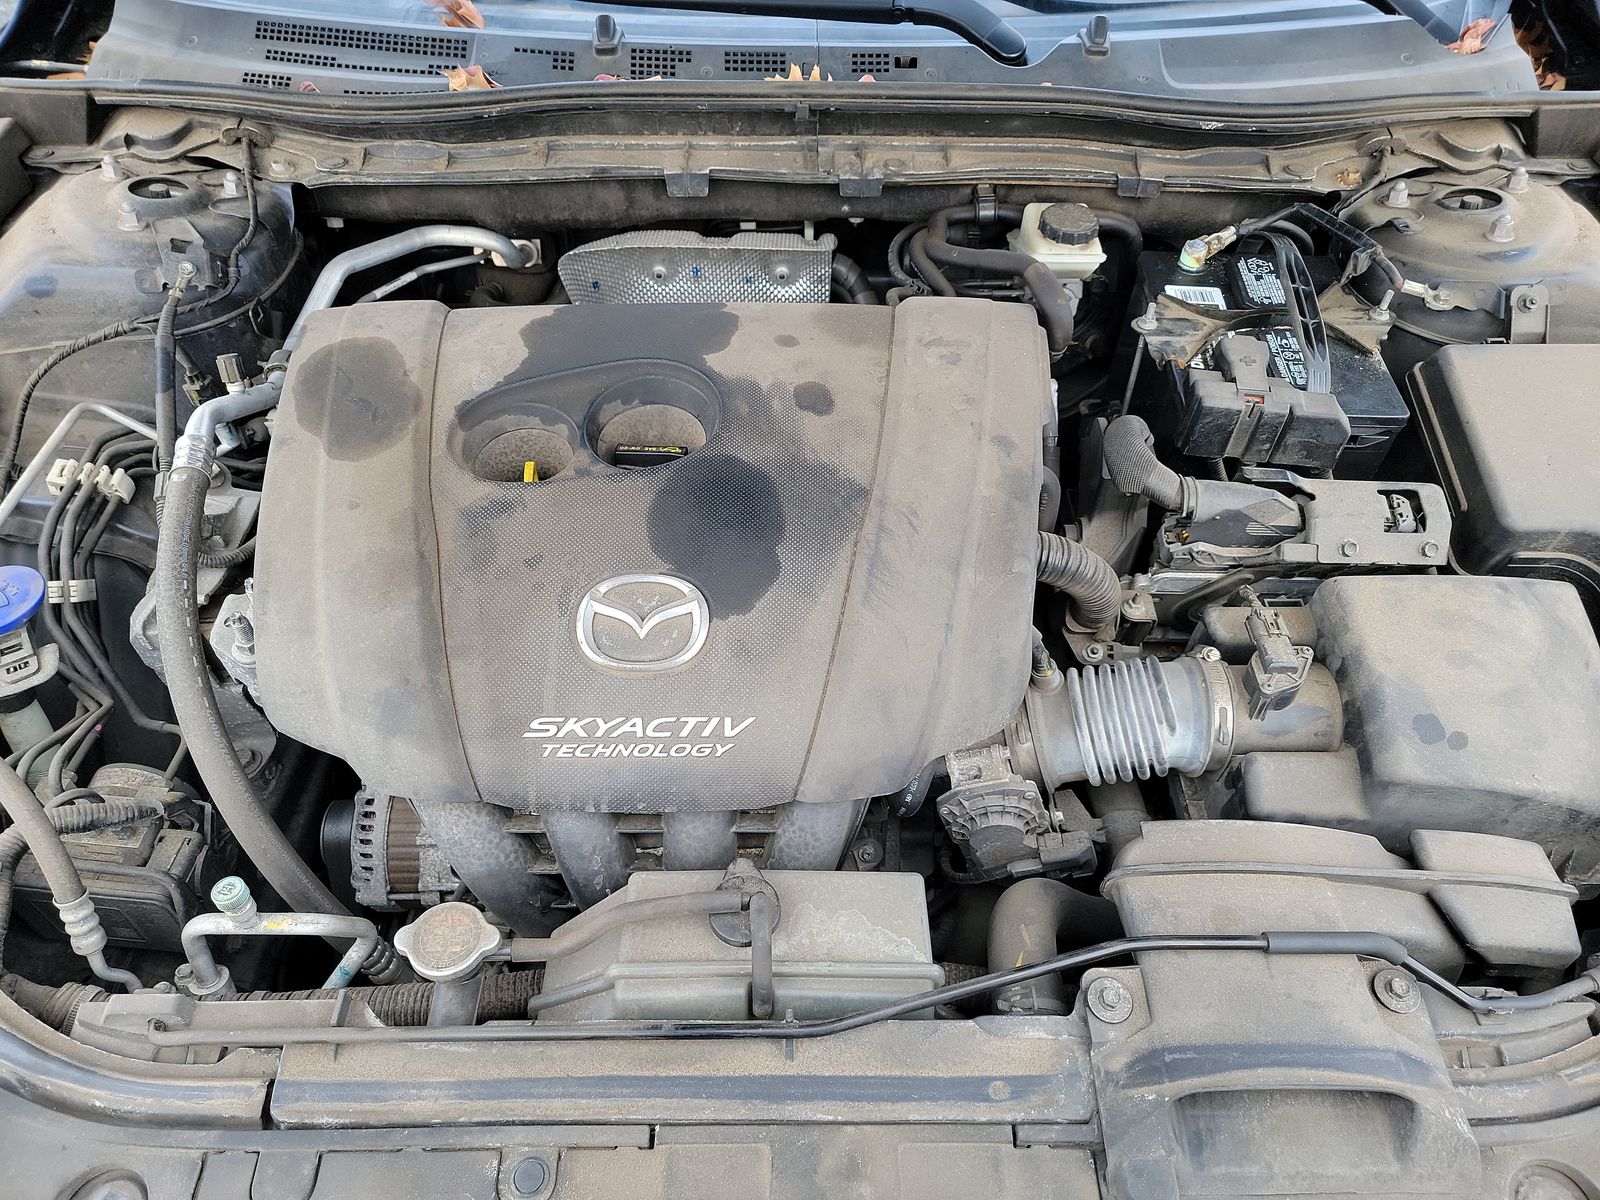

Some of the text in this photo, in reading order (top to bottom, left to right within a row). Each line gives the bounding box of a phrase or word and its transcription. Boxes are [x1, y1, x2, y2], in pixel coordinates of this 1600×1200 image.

[521, 716, 757, 738] SKYACTIV
[206, 709, 234, 769] GOODYEAR
[541, 743, 737, 758] TECHNOLOGY
